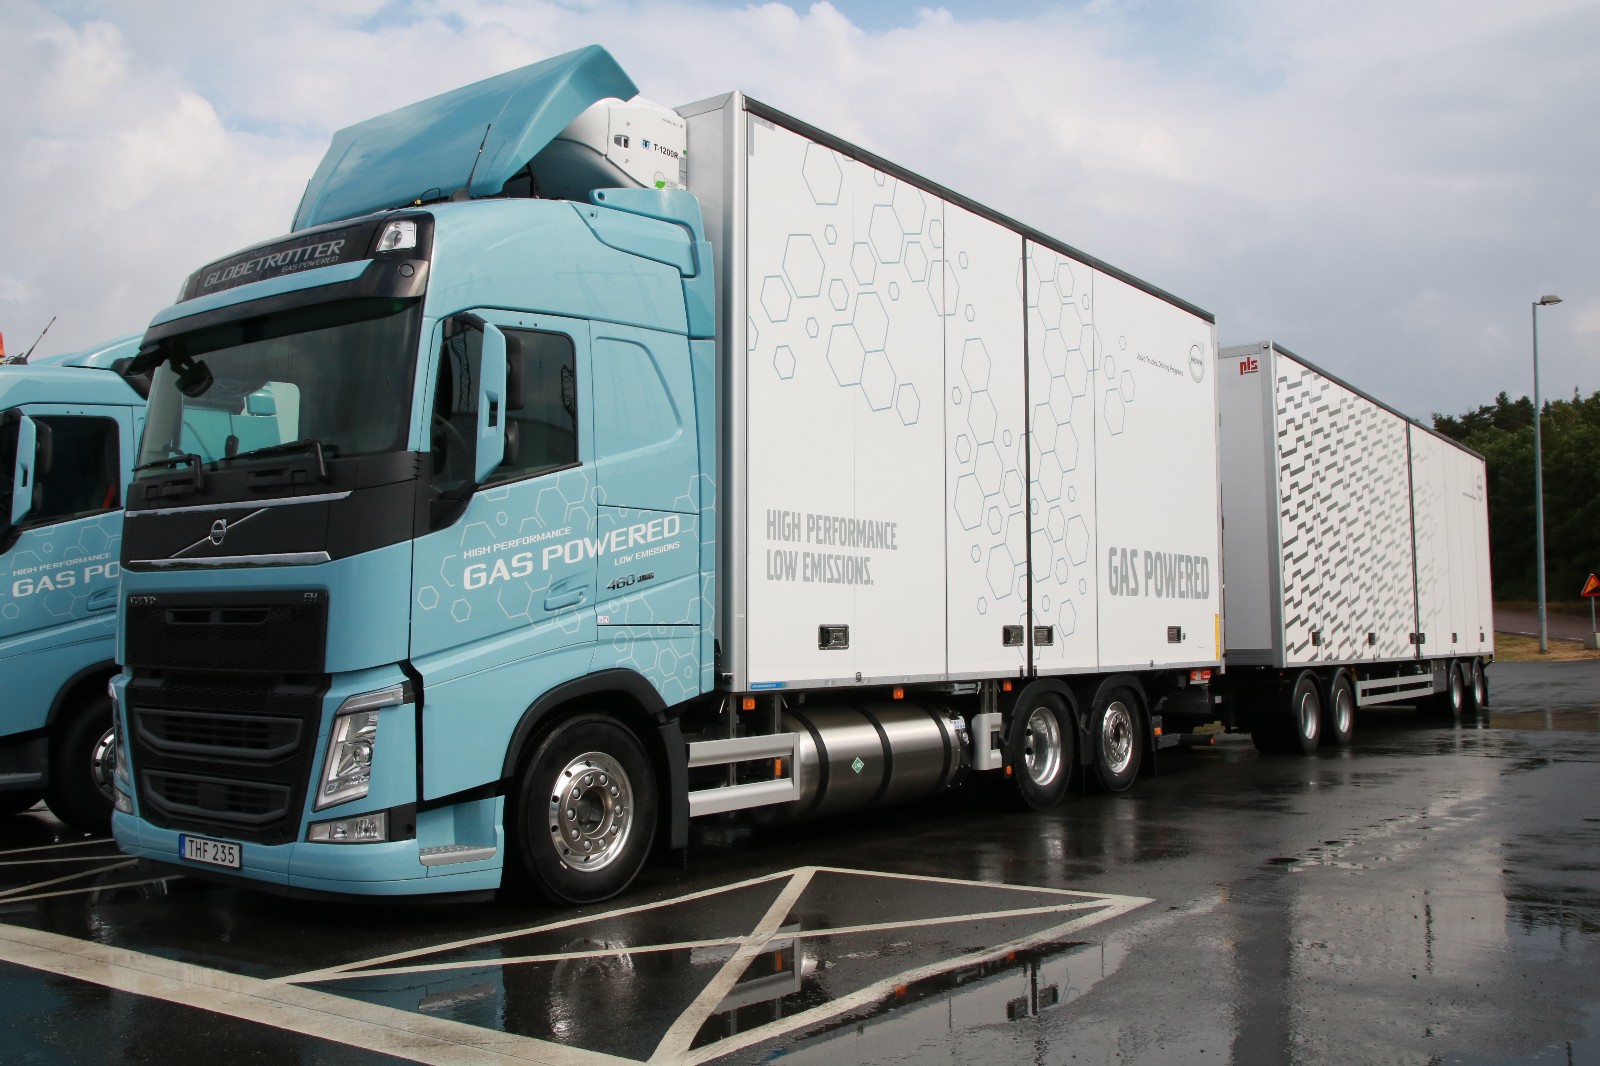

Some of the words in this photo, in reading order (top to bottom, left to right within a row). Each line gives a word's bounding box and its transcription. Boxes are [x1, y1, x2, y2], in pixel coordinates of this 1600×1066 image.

[204, 239, 346, 288] GLOBETROTTER
[281, 264, 298, 273] GAS
[298, 255, 339, 270] POWERED
[1240, 356, 1258, 376] pls
[463, 545, 490, 559] HIGH
[493, 526, 572, 551] PERFORMANCE
[766, 508, 801, 542] HIGH
[806, 513, 897, 550] PERFORMANCE
[12, 566, 37, 577] HIGH
[39, 552, 112, 571] PERFORMANCE
[463, 551, 533, 590] GAS
[542, 514, 680, 571] POWERED
[614, 553, 634, 566] LOW
[635, 541, 680, 561] EMISSIONS
[766, 549, 798, 582] LOW
[802, 551, 874, 586] EMISSIONS.
[1108, 546, 1139, 597] GAS
[1143, 550, 1210, 600] POWERED
[12, 570, 76, 598] GAS
[606, 573, 636, 591] 460
[188, 839, 209, 859] THF
[212, 843, 235, 864] 235
